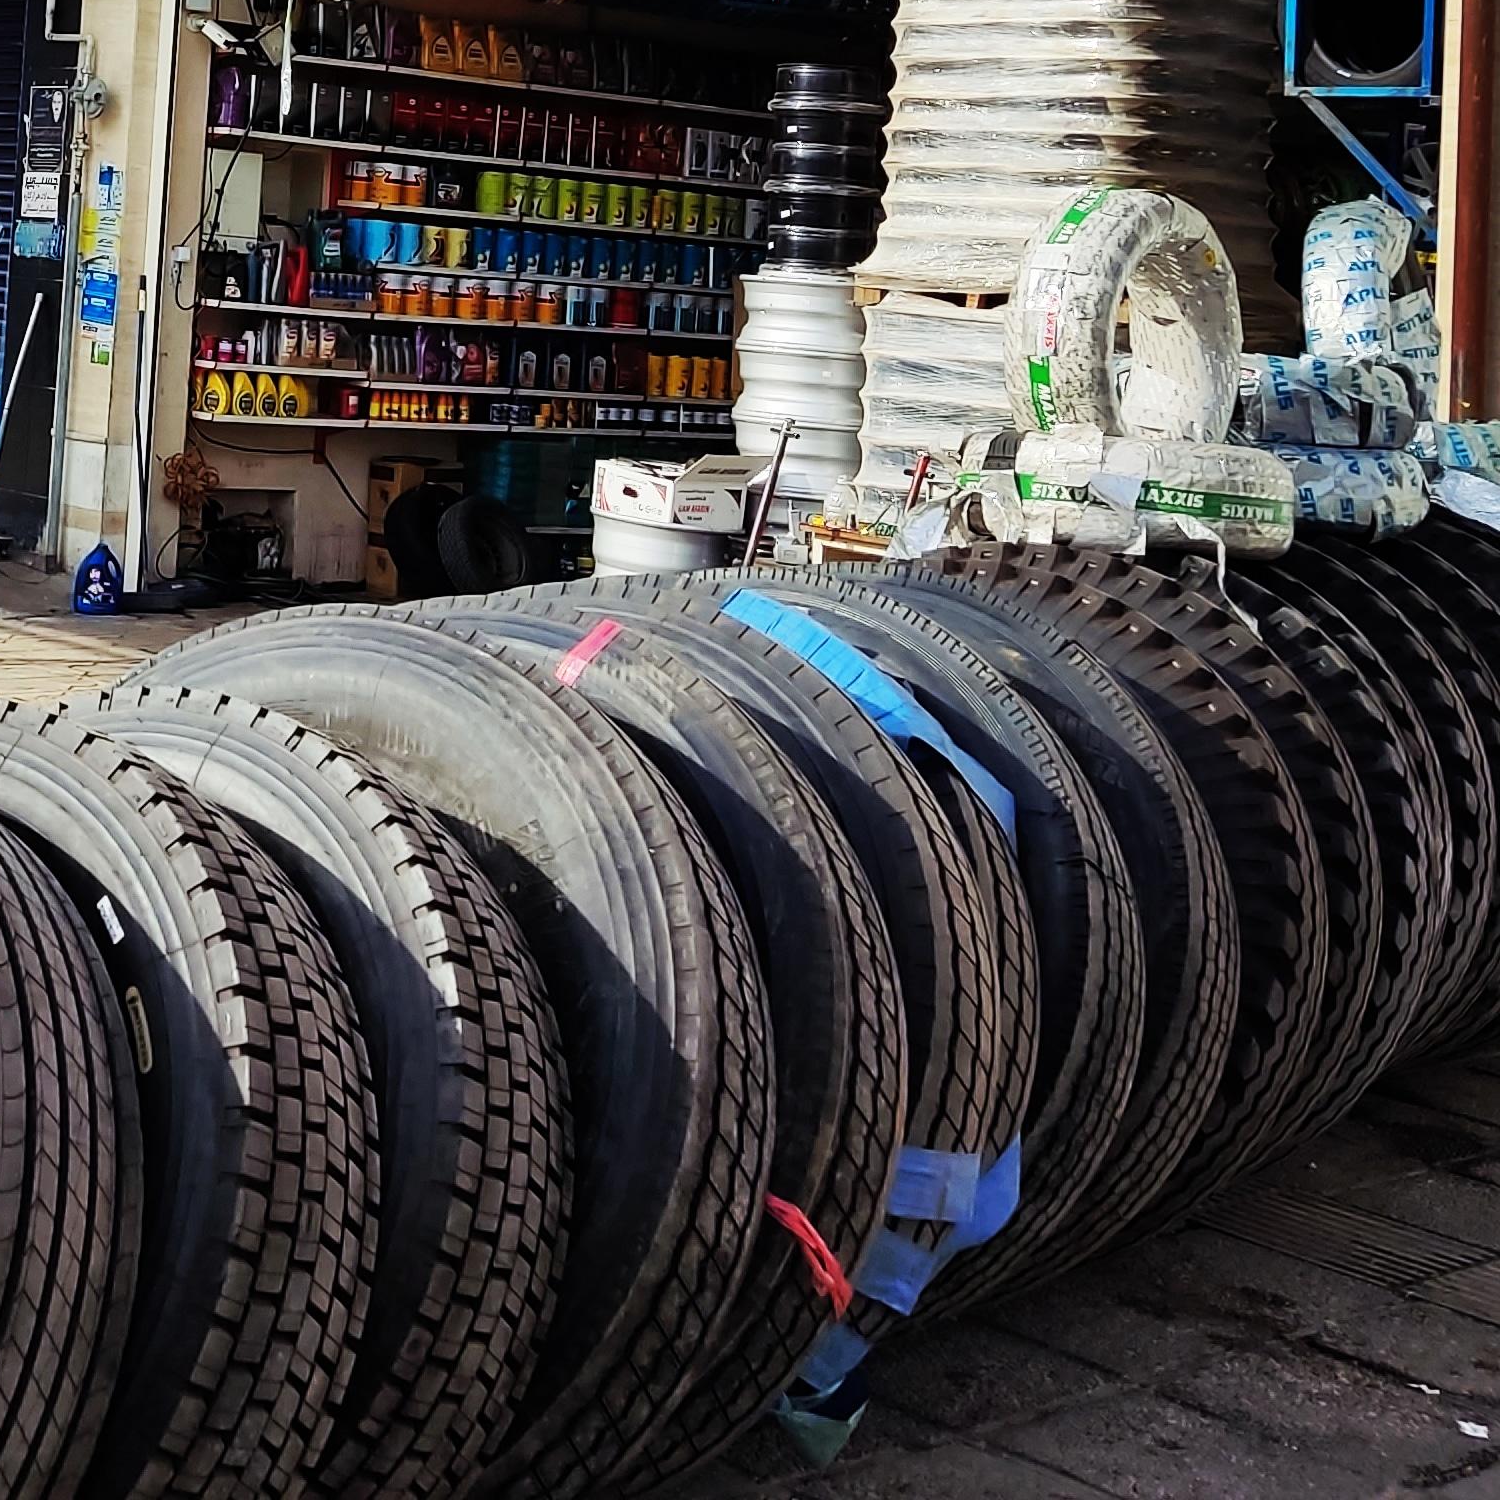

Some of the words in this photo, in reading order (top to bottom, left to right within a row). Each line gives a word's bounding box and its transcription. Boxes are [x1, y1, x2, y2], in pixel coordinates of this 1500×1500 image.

[1396, 307, 1433, 333] PLUS
[1402, 345, 1440, 358] PLUS
[1268, 355, 1295, 411] APLUS
[1139, 490, 1204, 509] AXXIS
[1221, 503, 1275, 521] MAXXIS
